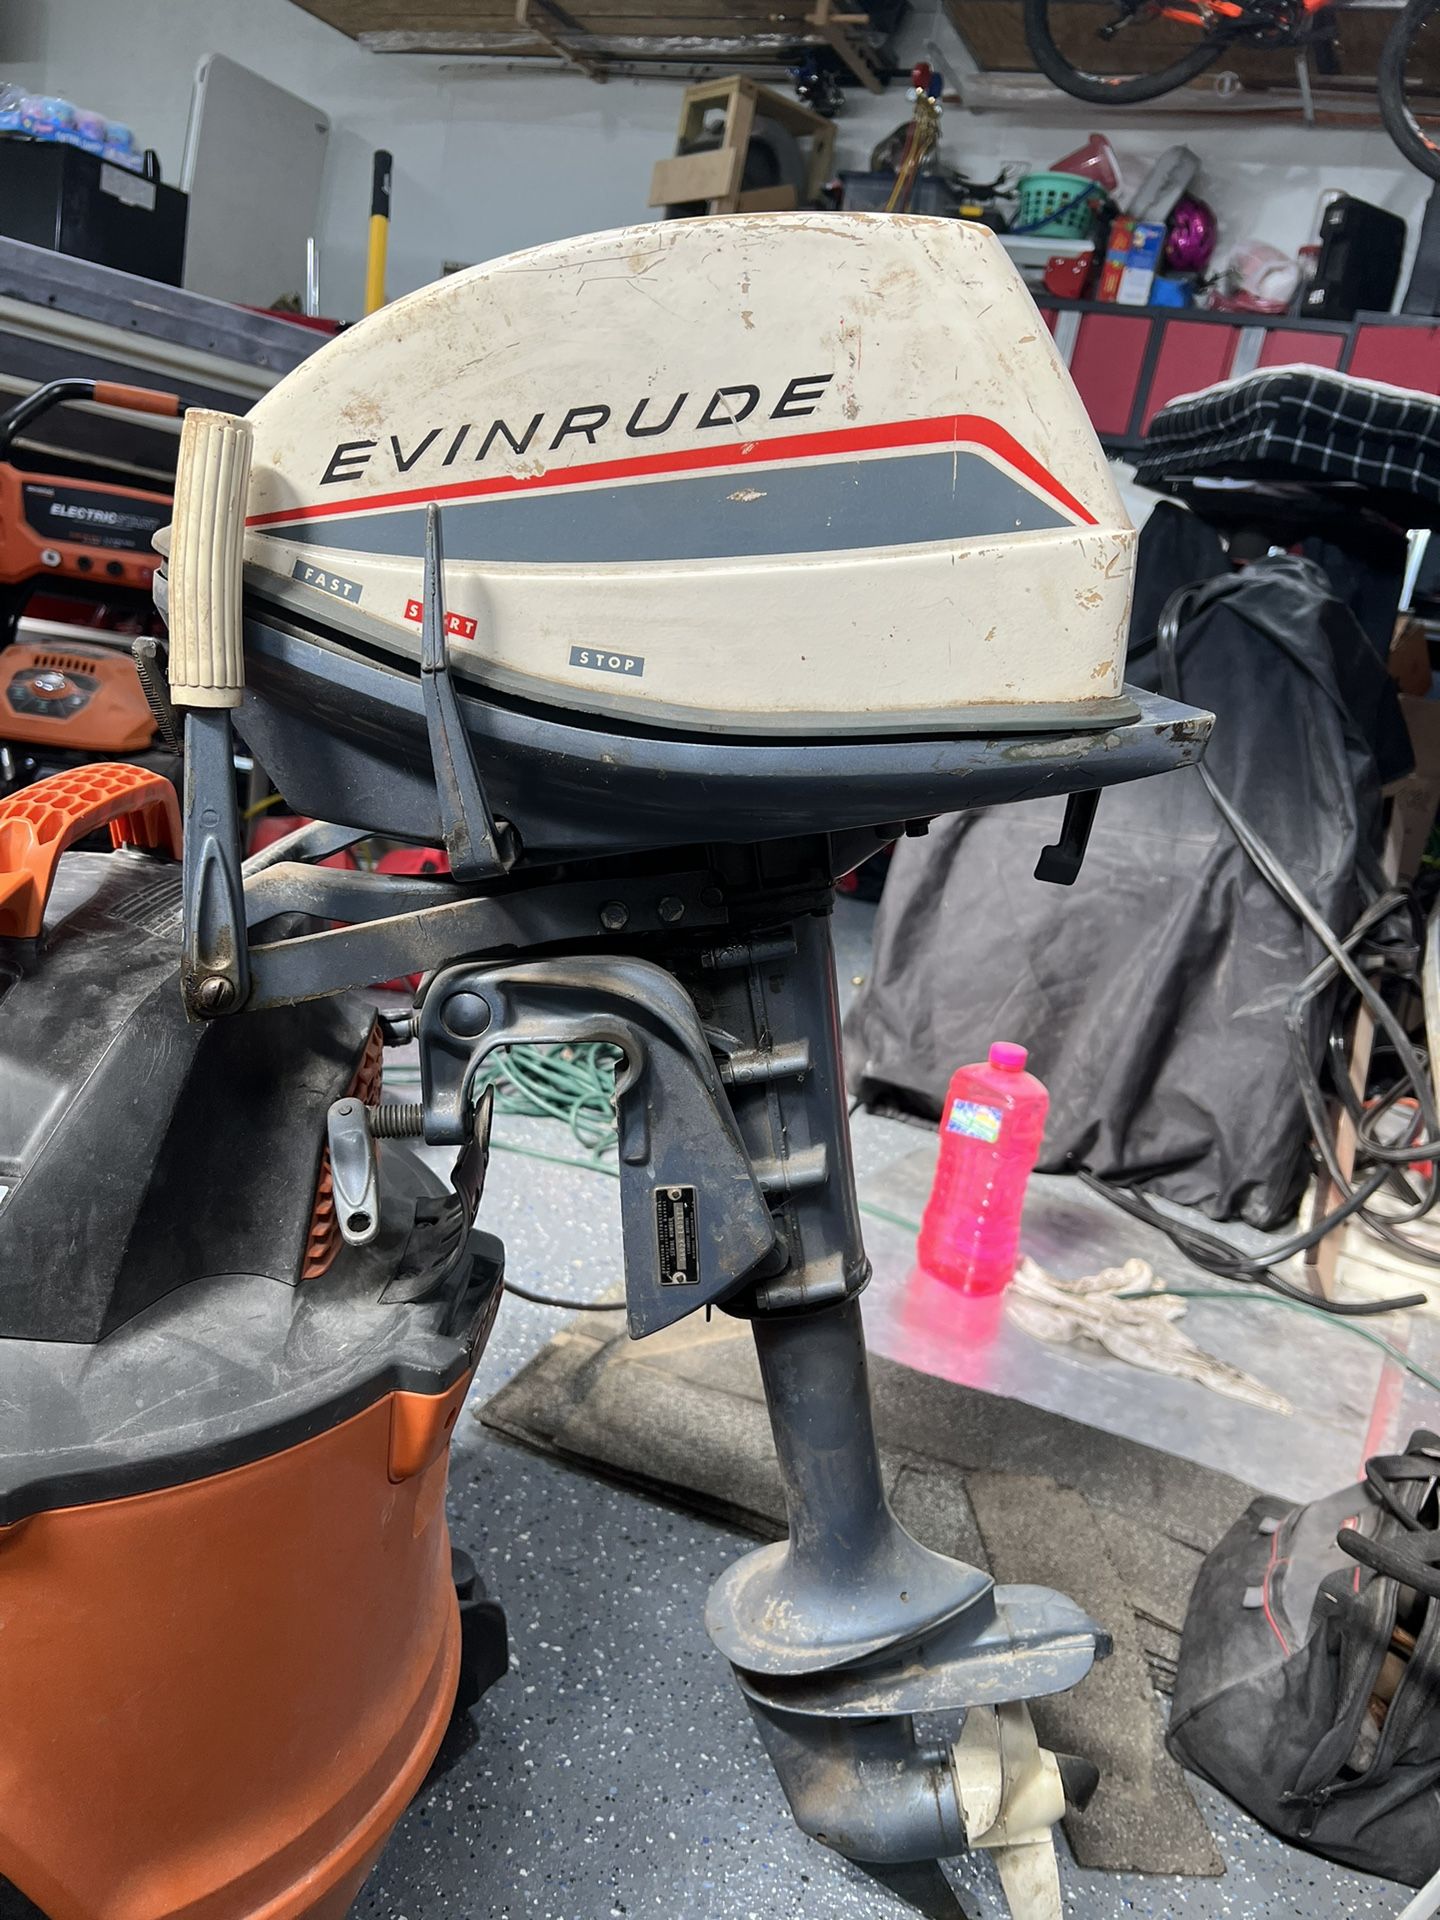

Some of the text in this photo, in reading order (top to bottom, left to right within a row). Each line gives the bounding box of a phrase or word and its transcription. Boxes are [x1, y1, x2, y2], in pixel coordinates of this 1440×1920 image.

[320, 373, 834, 485] EVINRUDE
[50, 502, 118, 525] ELECTRIC
[304, 567, 352, 597] FAST
[409, 604, 474, 634] SRT
[579, 651, 634, 671] STOP
